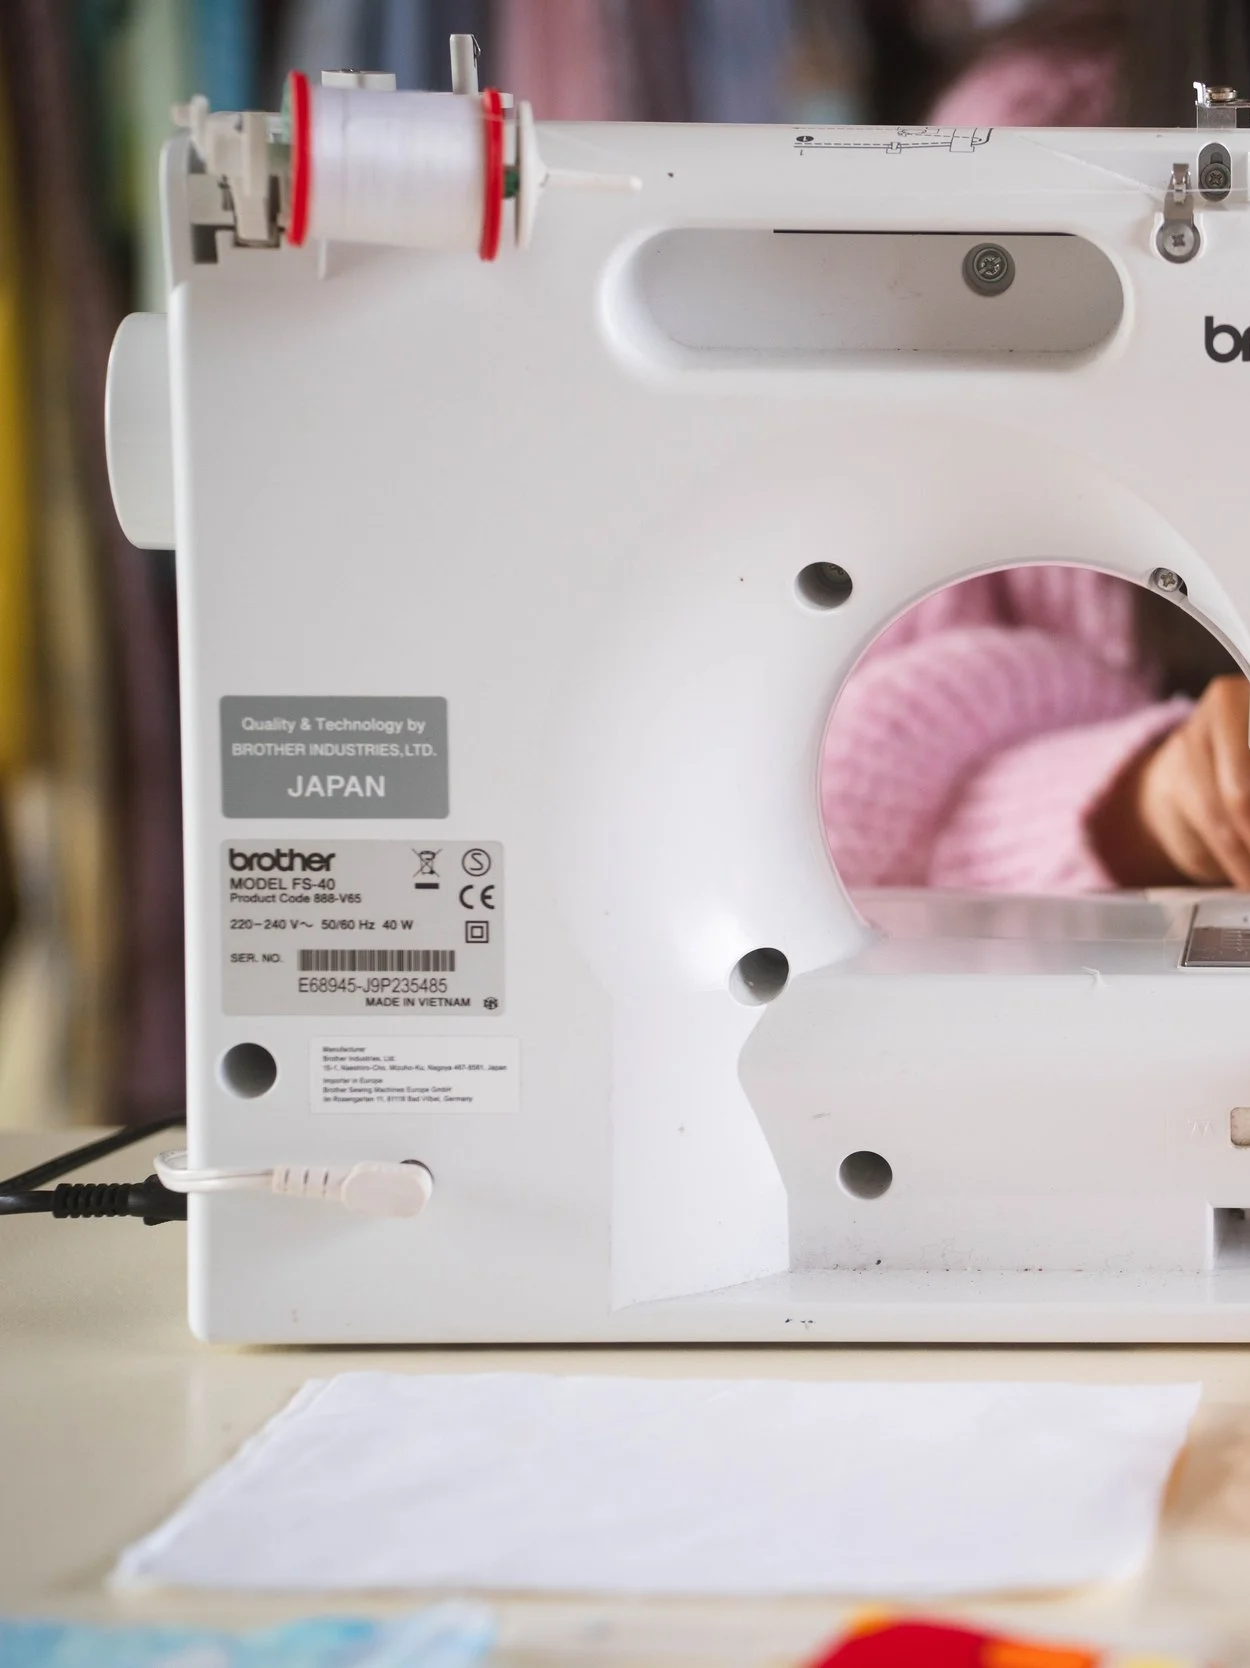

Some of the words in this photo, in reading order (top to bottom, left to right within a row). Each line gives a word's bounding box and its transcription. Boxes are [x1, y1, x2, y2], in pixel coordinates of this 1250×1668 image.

[241, 717, 297, 734] Quality
[300, 717, 312, 731] &
[315, 717, 403, 735] Technology
[407, 718, 426, 734] by
[231, 743, 305, 757] BROTHER
[287, 775, 386, 798] JAPAN
[228, 848, 336, 872] brother
[230, 877, 288, 890] MODEL
[292, 877, 336, 890] FS-40
[229, 892, 276, 903] Product
[279, 892, 311, 904] Code
[313, 893, 362, 904] 888-V65
[321, 919, 355, 930] 50/60
[358, 919, 376, 930] Hz
[382, 919, 398, 930] 40
[400, 919, 414, 930] W
[230, 953, 258, 964] SER.
[262, 953, 284, 964] NO.
[297, 977, 448, 994] E68945-J9P235485
[365, 997, 400, 1007] MADE
[403, 997, 415, 1007] IN
[418, 997, 471, 1008] VIETNAM
